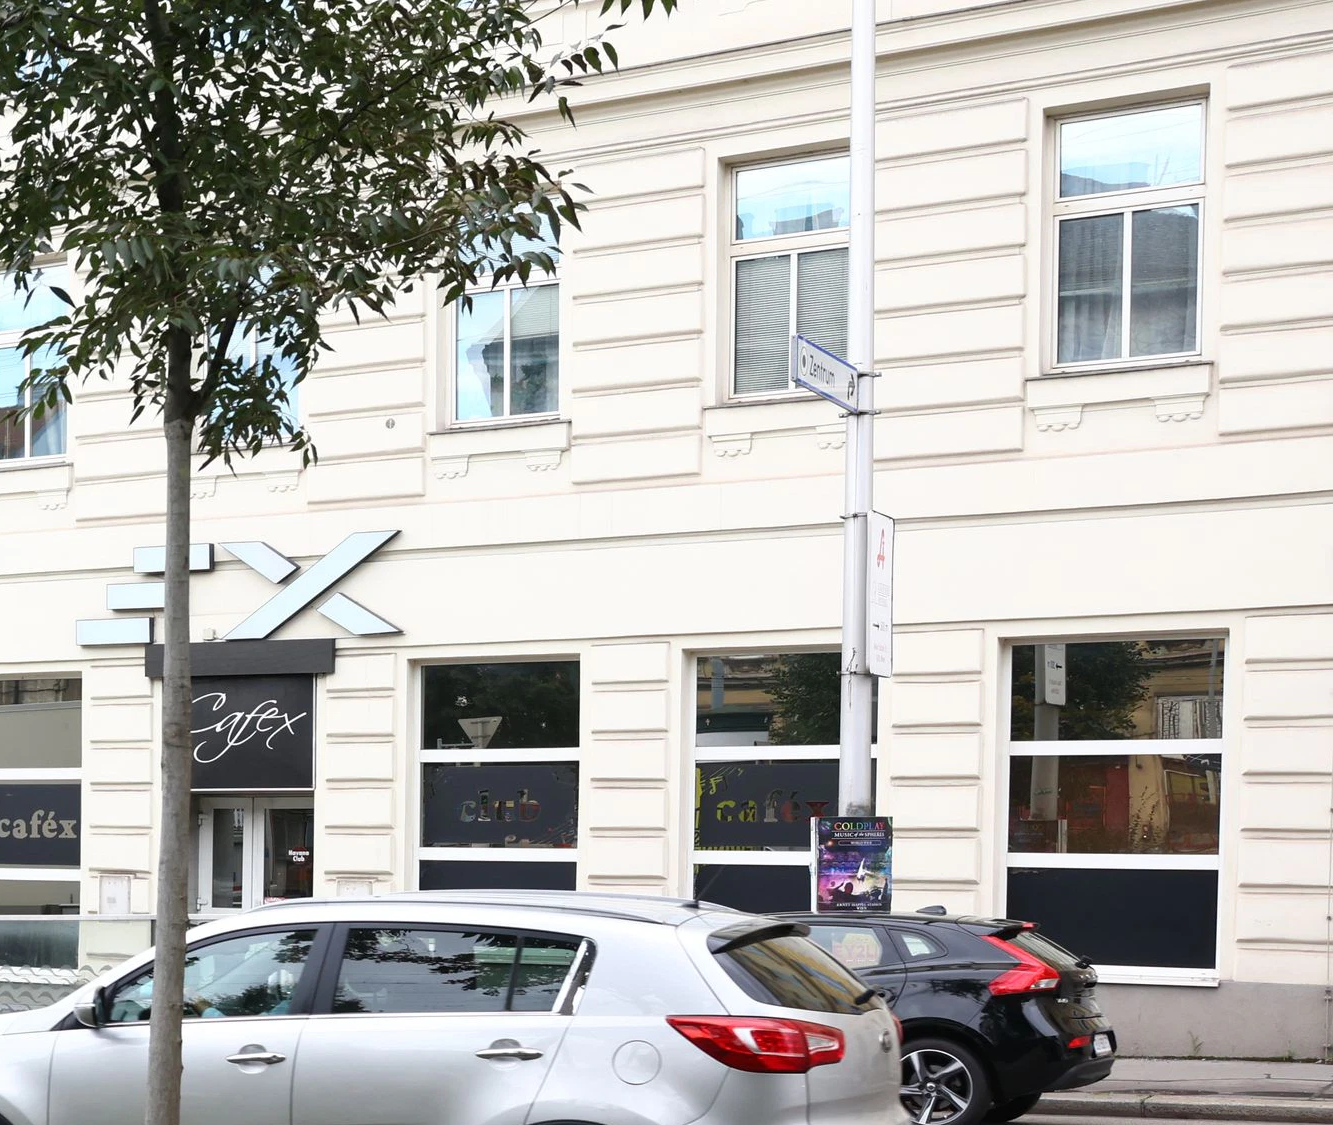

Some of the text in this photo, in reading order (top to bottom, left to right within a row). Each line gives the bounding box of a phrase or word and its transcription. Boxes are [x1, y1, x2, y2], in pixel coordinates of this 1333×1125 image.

[809, 355, 835, 388] Zentrum
[460, 788, 542, 823] club
[716, 788, 830, 823] caféx
[833, 821, 885, 831] COLDPLAY
